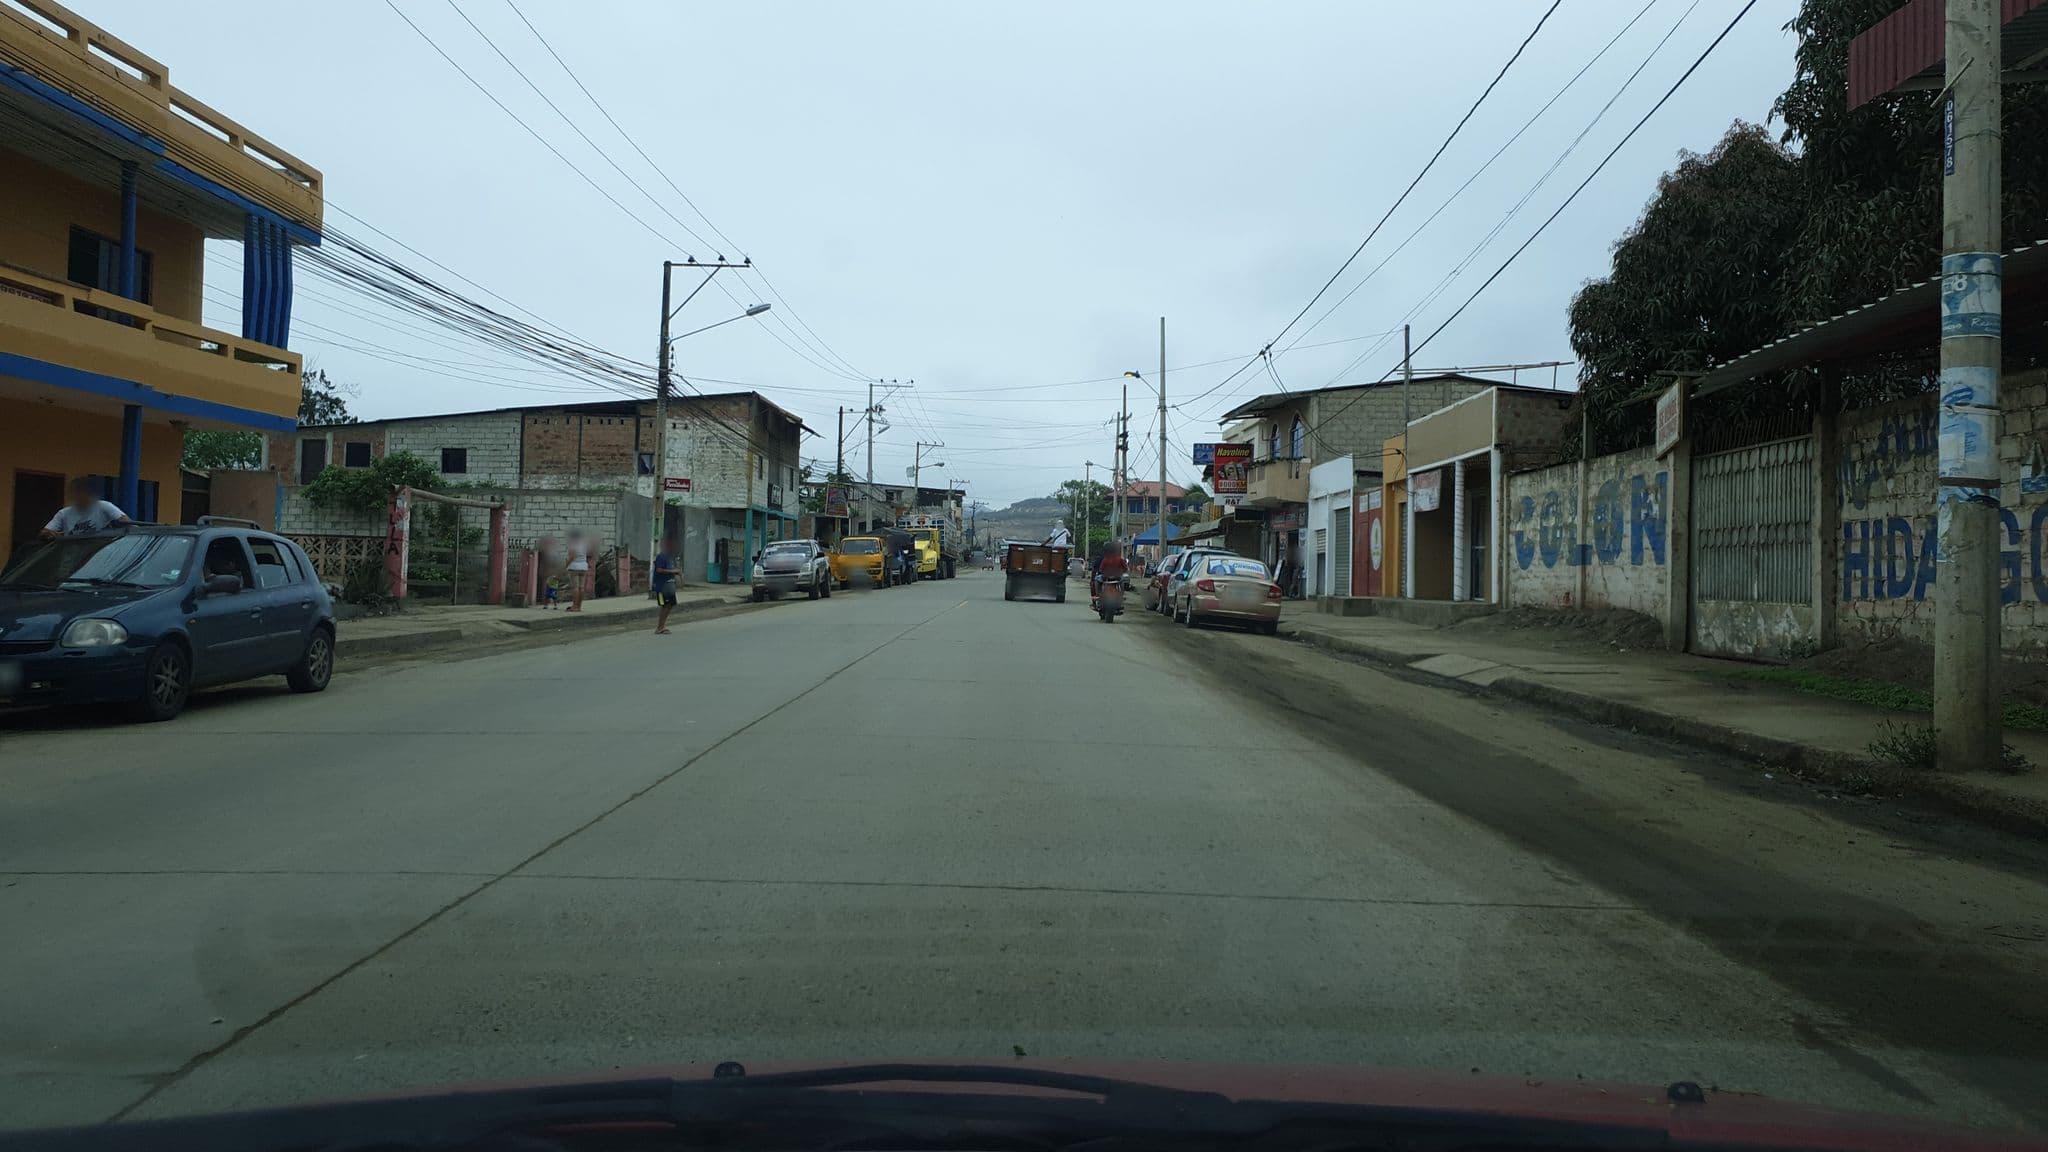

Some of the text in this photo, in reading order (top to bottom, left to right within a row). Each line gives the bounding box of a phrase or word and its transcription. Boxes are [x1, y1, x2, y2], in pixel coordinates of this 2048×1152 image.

[1946, 100, 1954, 168] 061578
[1217, 448, 1250, 457] Havoline
[1842, 503, 2048, 605] HIDAGO
